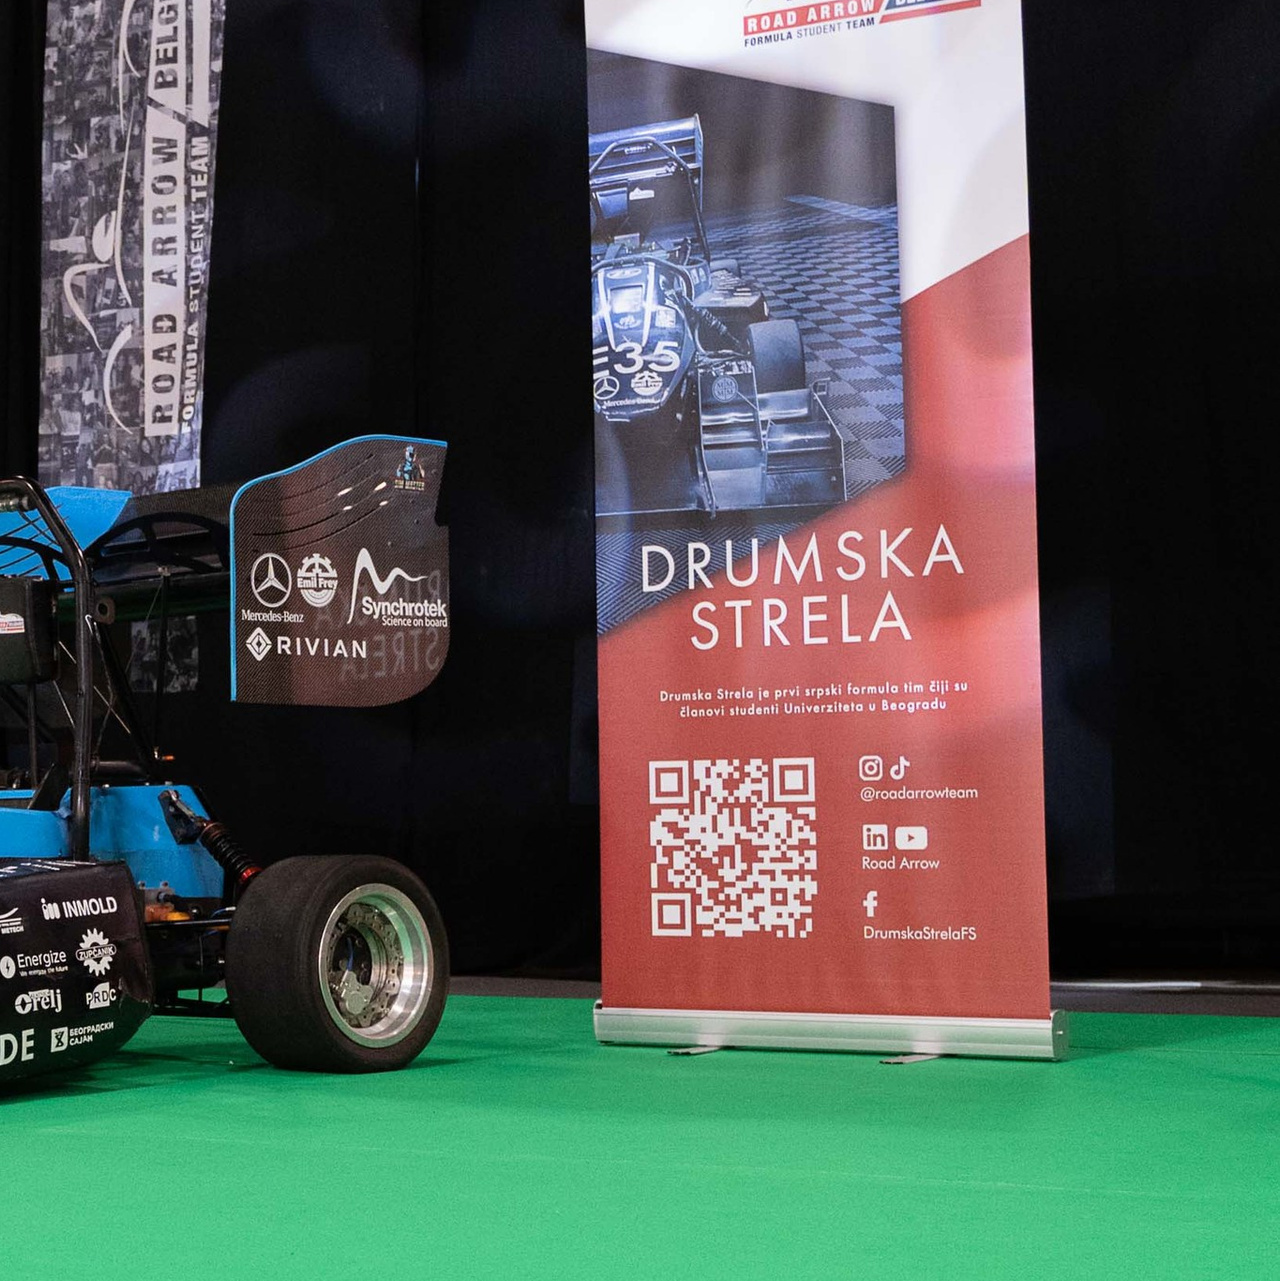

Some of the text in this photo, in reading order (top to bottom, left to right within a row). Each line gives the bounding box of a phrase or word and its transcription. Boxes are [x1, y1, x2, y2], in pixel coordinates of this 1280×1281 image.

[744, 16, 875, 47] FORMULA STUDENT TEAM
[747, 11, 797, 33] ROAD
[150, 135, 179, 422] ROAD ARROW
[181, 136, 210, 434] FORMULA STUDENT TEAM
[641, 523, 964, 593] DRUMSKA
[297, 578, 338, 590] Emil Frey
[241, 609, 304, 623] Mercedes-Benz
[362, 596, 447, 619] Synchrotek
[382, 615, 447, 627] Science on board
[690, 590, 912, 650] STRELA
[277, 636, 367, 659] RIVIAN
[660, 680, 968, 702] Drumska Strela je prvi srpski formula tim čiji su
[680, 698, 947, 718] članovi studenti Univerziteta u Beogradu
[860, 786, 978, 802] @roadarrowteam
[862, 856, 940, 869] Road Arrow
[62, 896, 118, 918] INMOLD
[863, 926, 977, 940] DrumskaStrelaFS
[17, 950, 66, 968] Energize
[78, 945, 114, 960] ZUPČANIK
[85, 988, 117, 1006] PRDC
[69, 1022, 114, 1037] БЕОГРАДСКИ
[69, 1034, 93, 1046] САЈАМ
